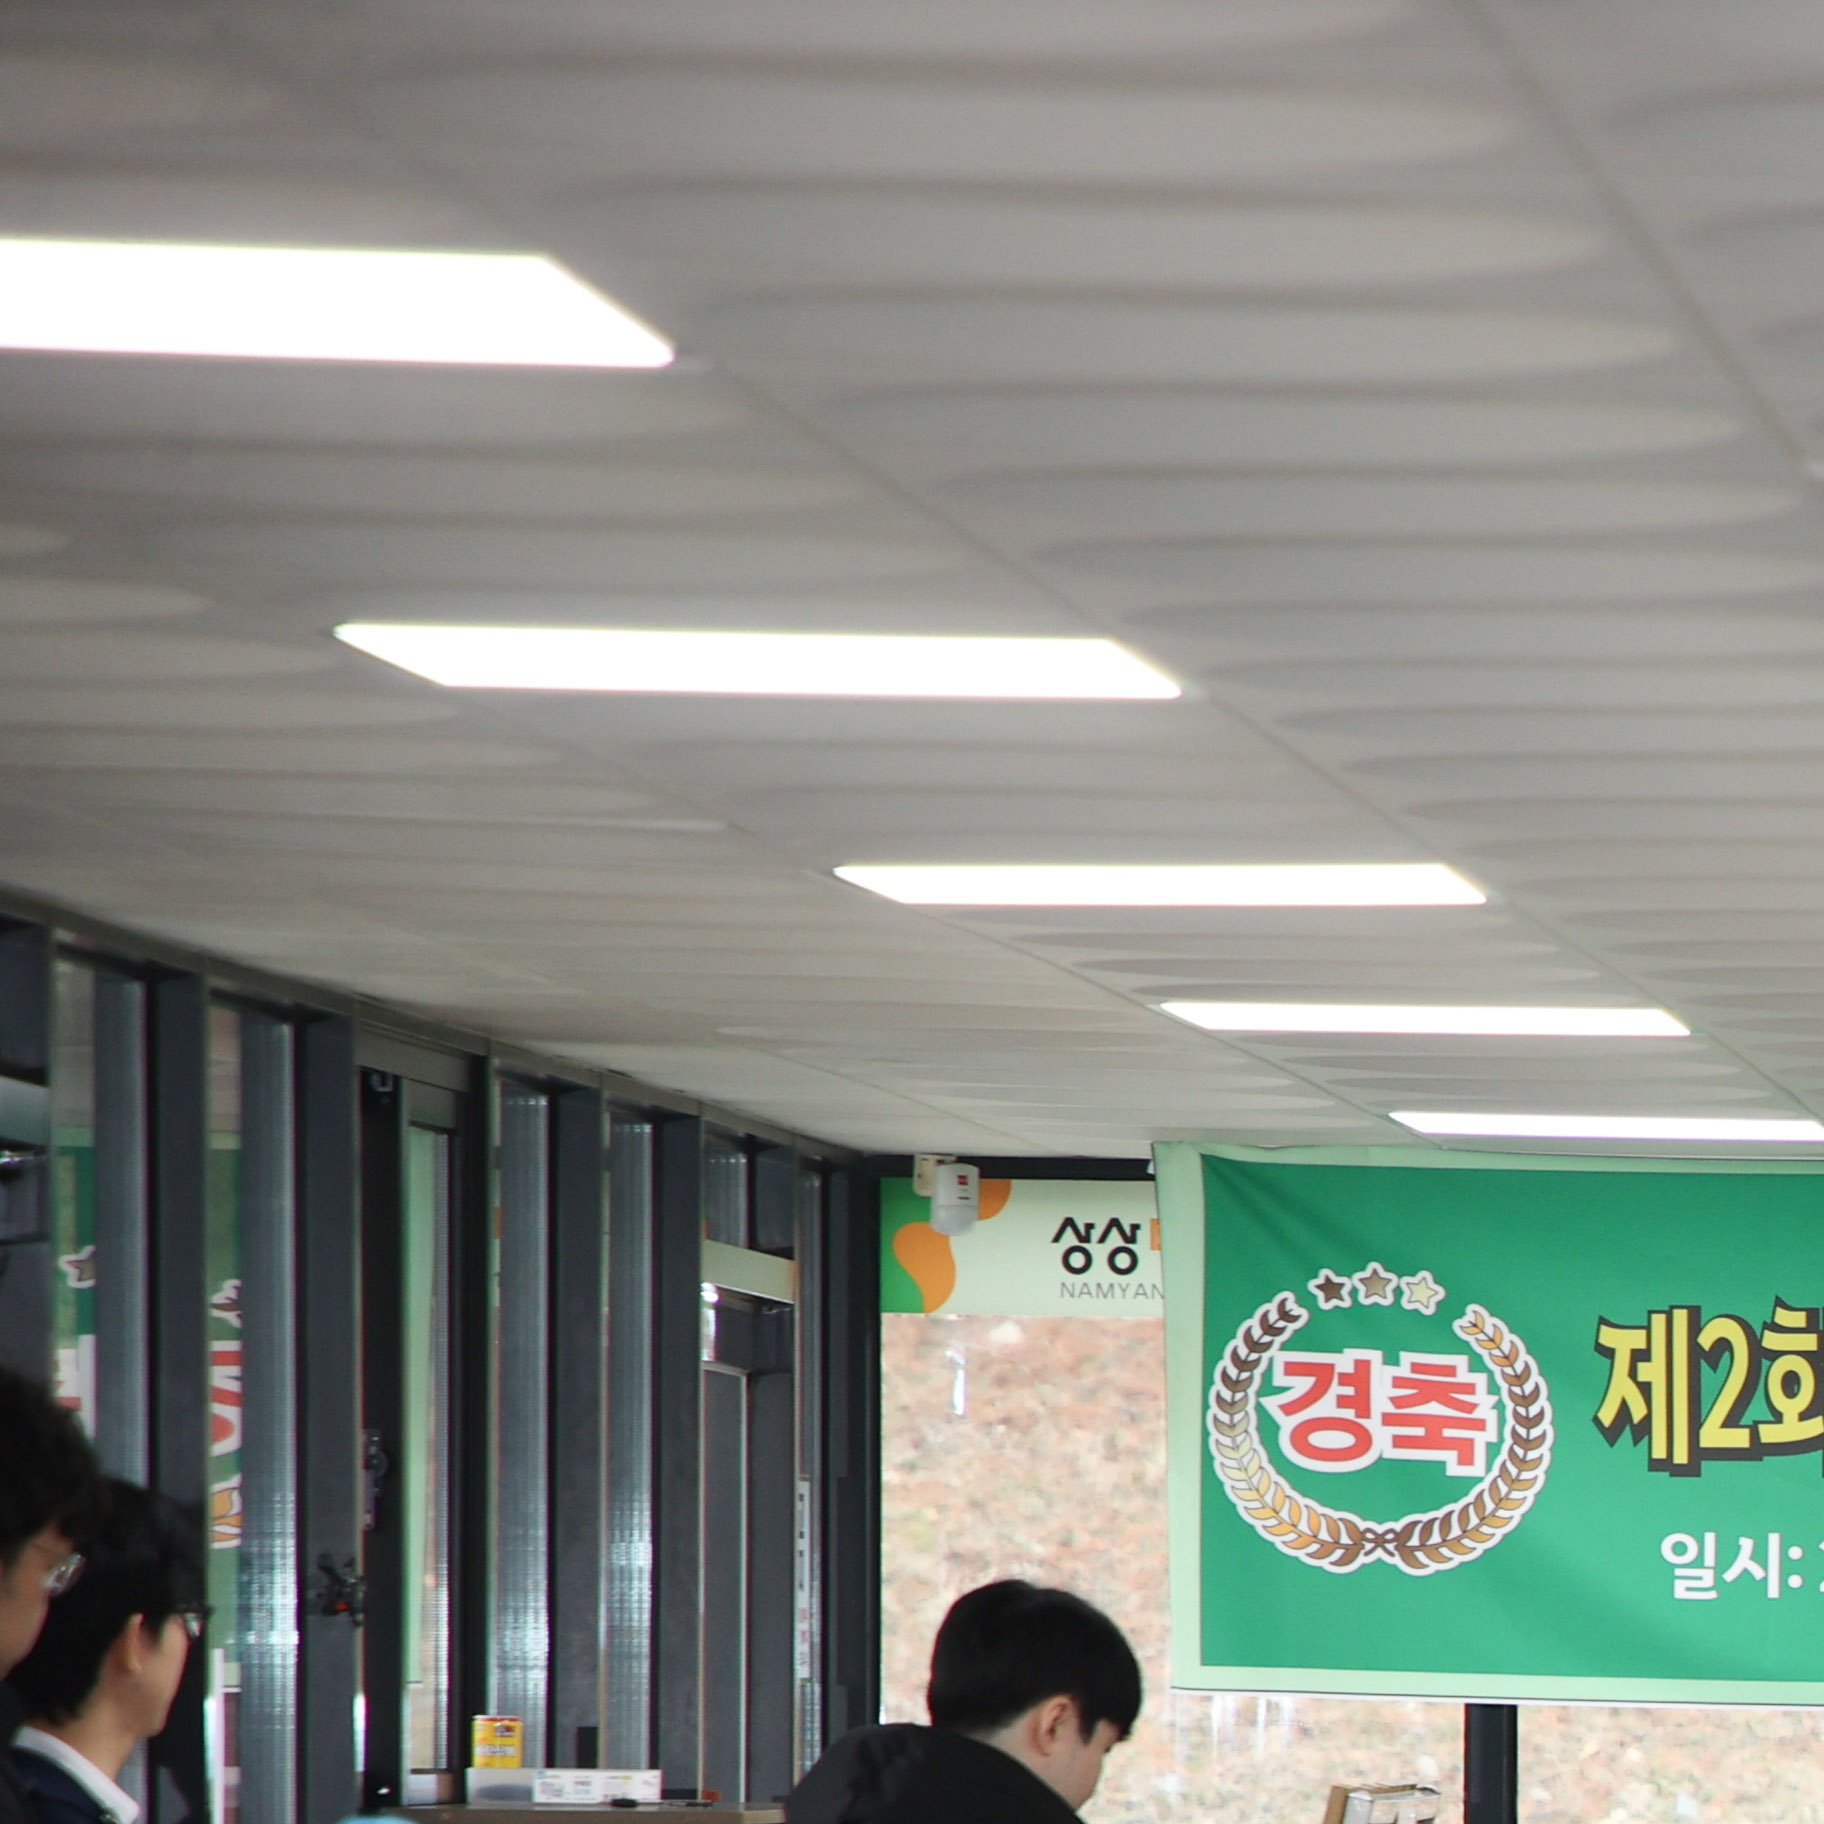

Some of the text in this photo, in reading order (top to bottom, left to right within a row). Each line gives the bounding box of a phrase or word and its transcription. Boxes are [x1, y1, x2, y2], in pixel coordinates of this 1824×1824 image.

[1051, 1217, 1141, 1275] 상상
[1268, 1352, 1498, 1473] 경축
[1659, 1530, 1804, 1600] 일시:
